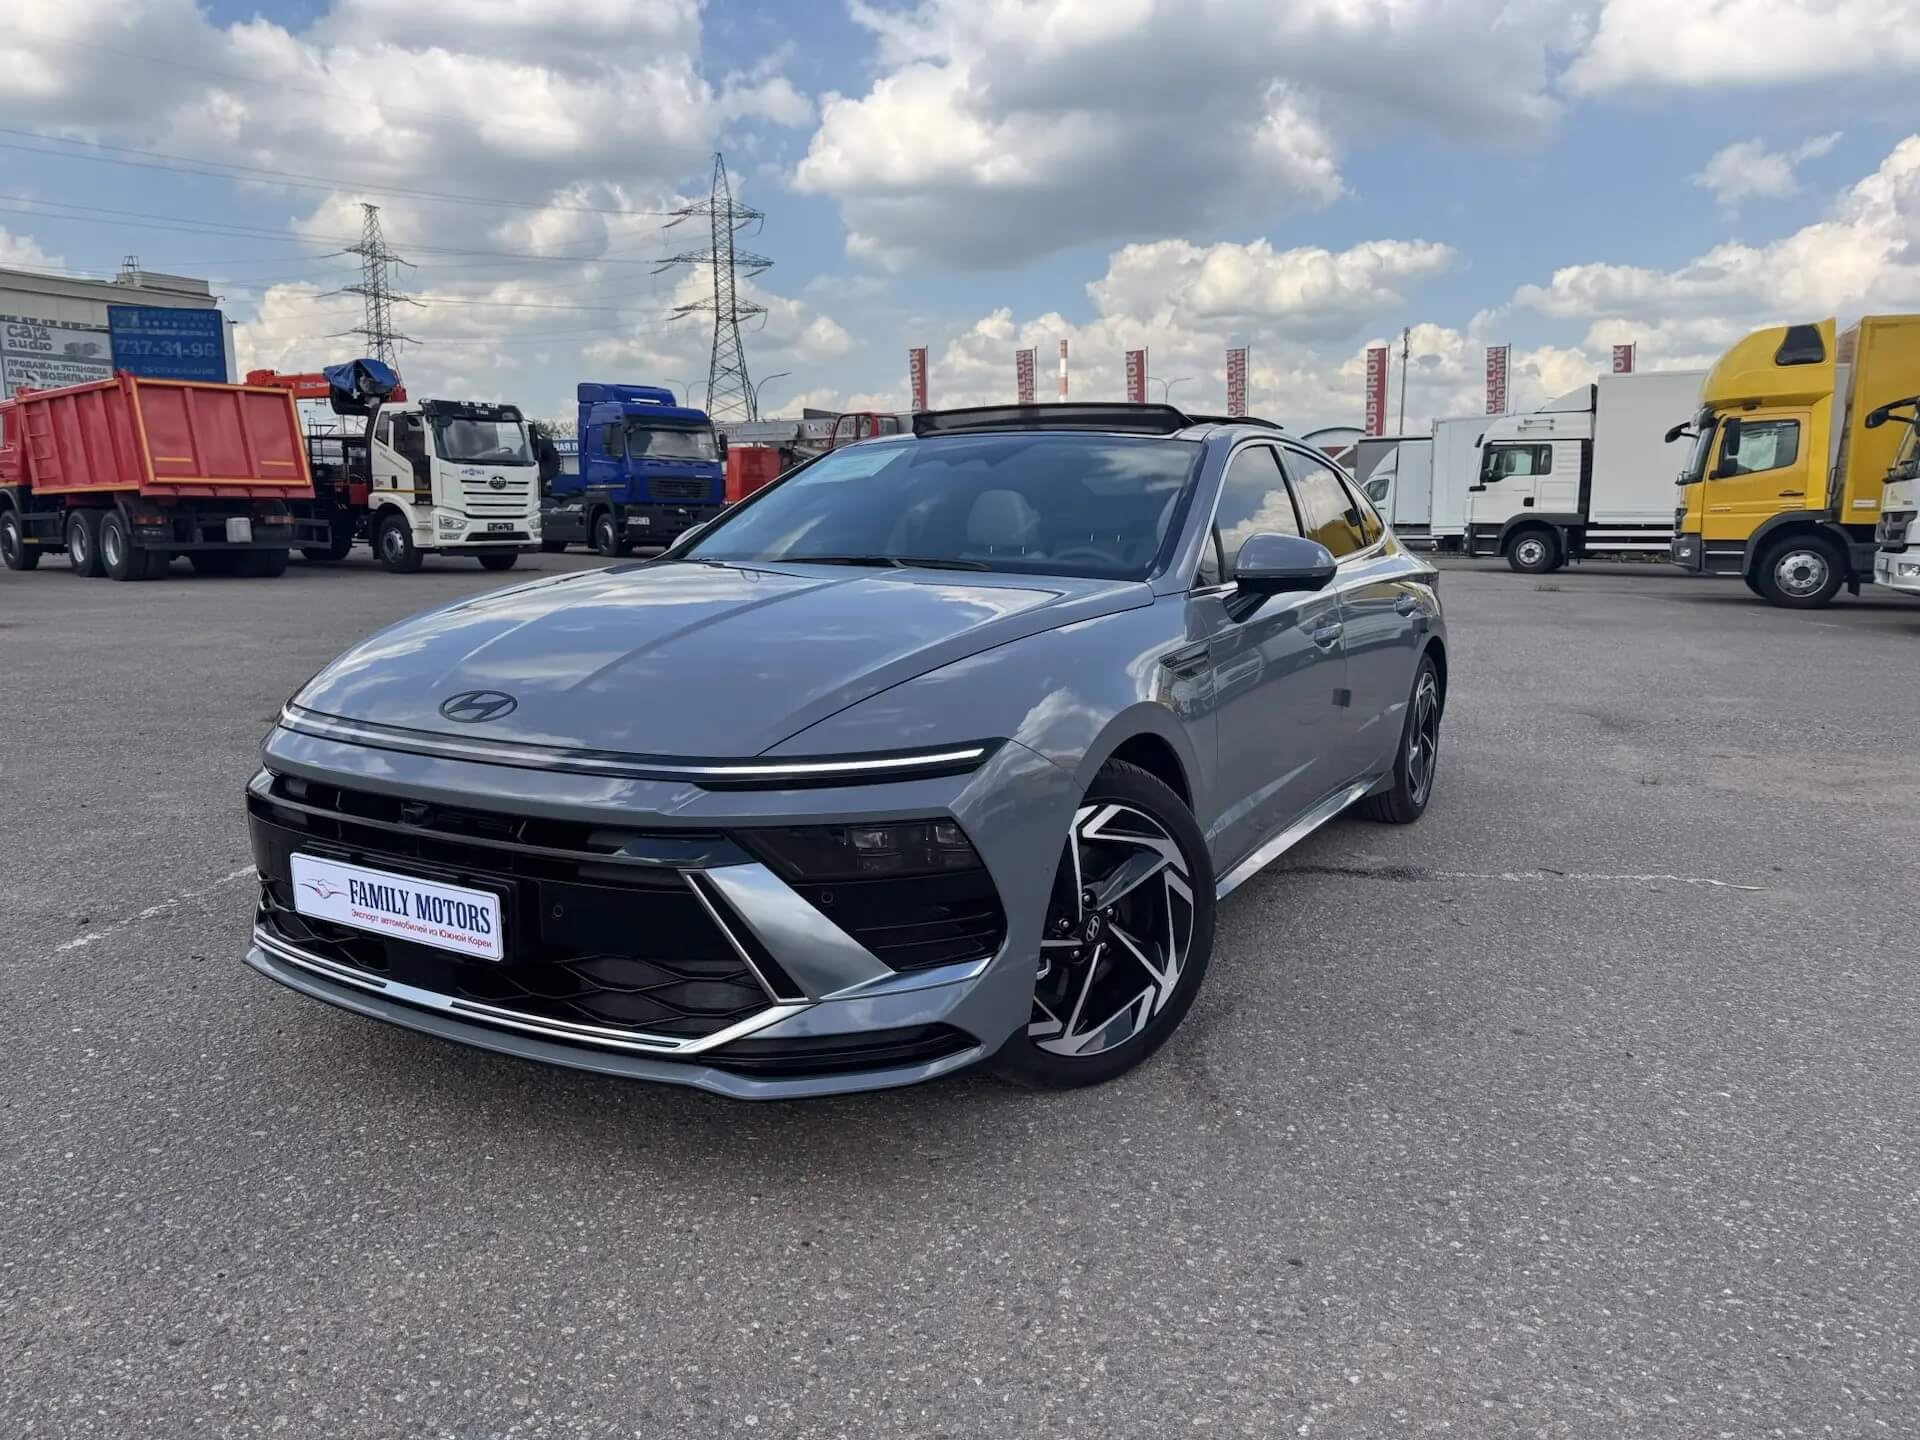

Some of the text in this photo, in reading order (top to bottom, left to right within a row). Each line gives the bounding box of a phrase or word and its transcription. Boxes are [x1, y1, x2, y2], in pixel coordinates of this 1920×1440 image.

[7, 359, 52, 370] ПРОДАЖА
[348, 878, 491, 934] FAMILY MOTORS
[351, 908, 492, 948] Экспорт автомобилей из Южной Кореи
